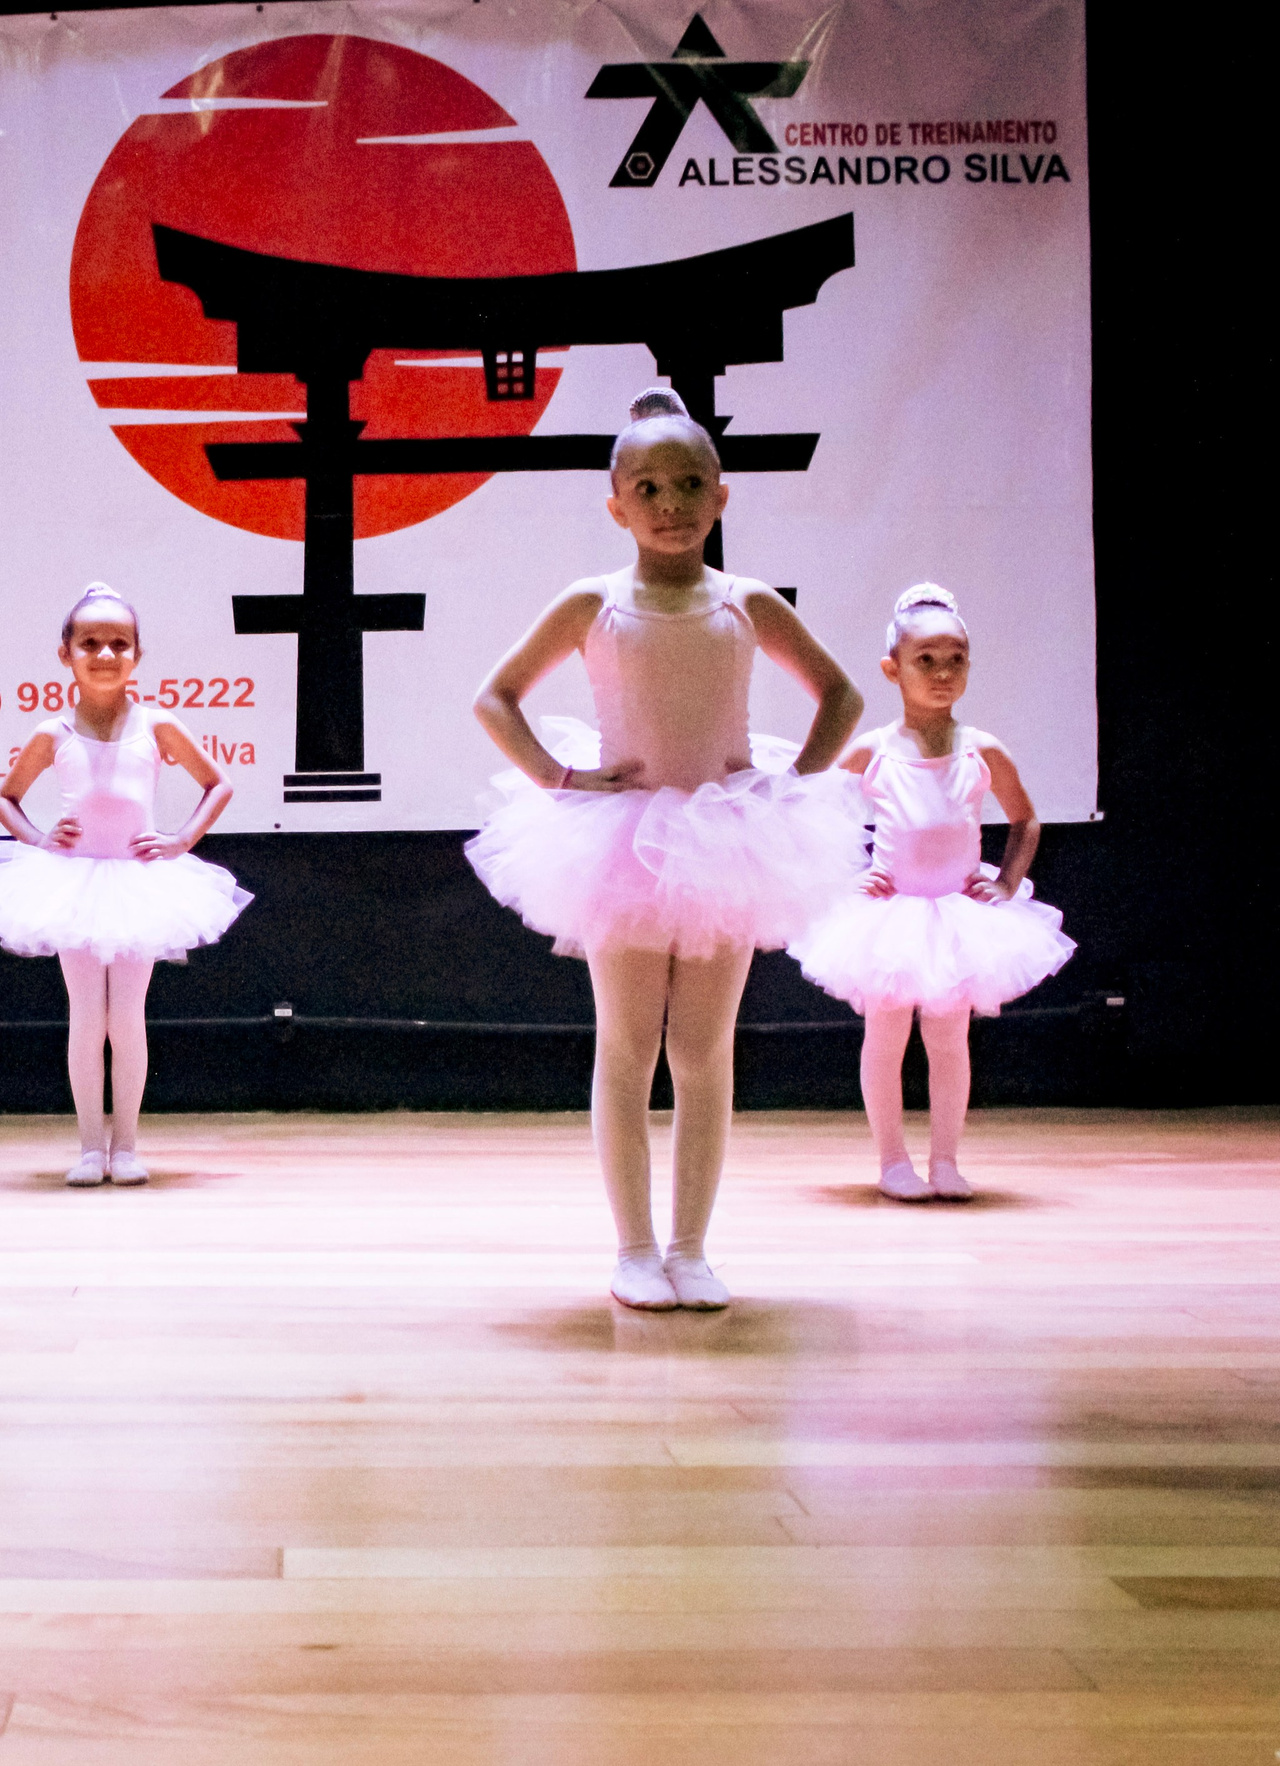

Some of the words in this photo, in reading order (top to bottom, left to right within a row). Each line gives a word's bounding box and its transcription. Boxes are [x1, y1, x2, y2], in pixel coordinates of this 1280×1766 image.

[785, 123, 868, 146] CENTRO
[876, 123, 901, 146] DE
[907, 120, 1057, 145] TREINAMENTO
[678, 155, 950, 187] ALESSANDRO
[964, 153, 1071, 184] SILVA
[17, 677, 255, 711] 9805-5222
